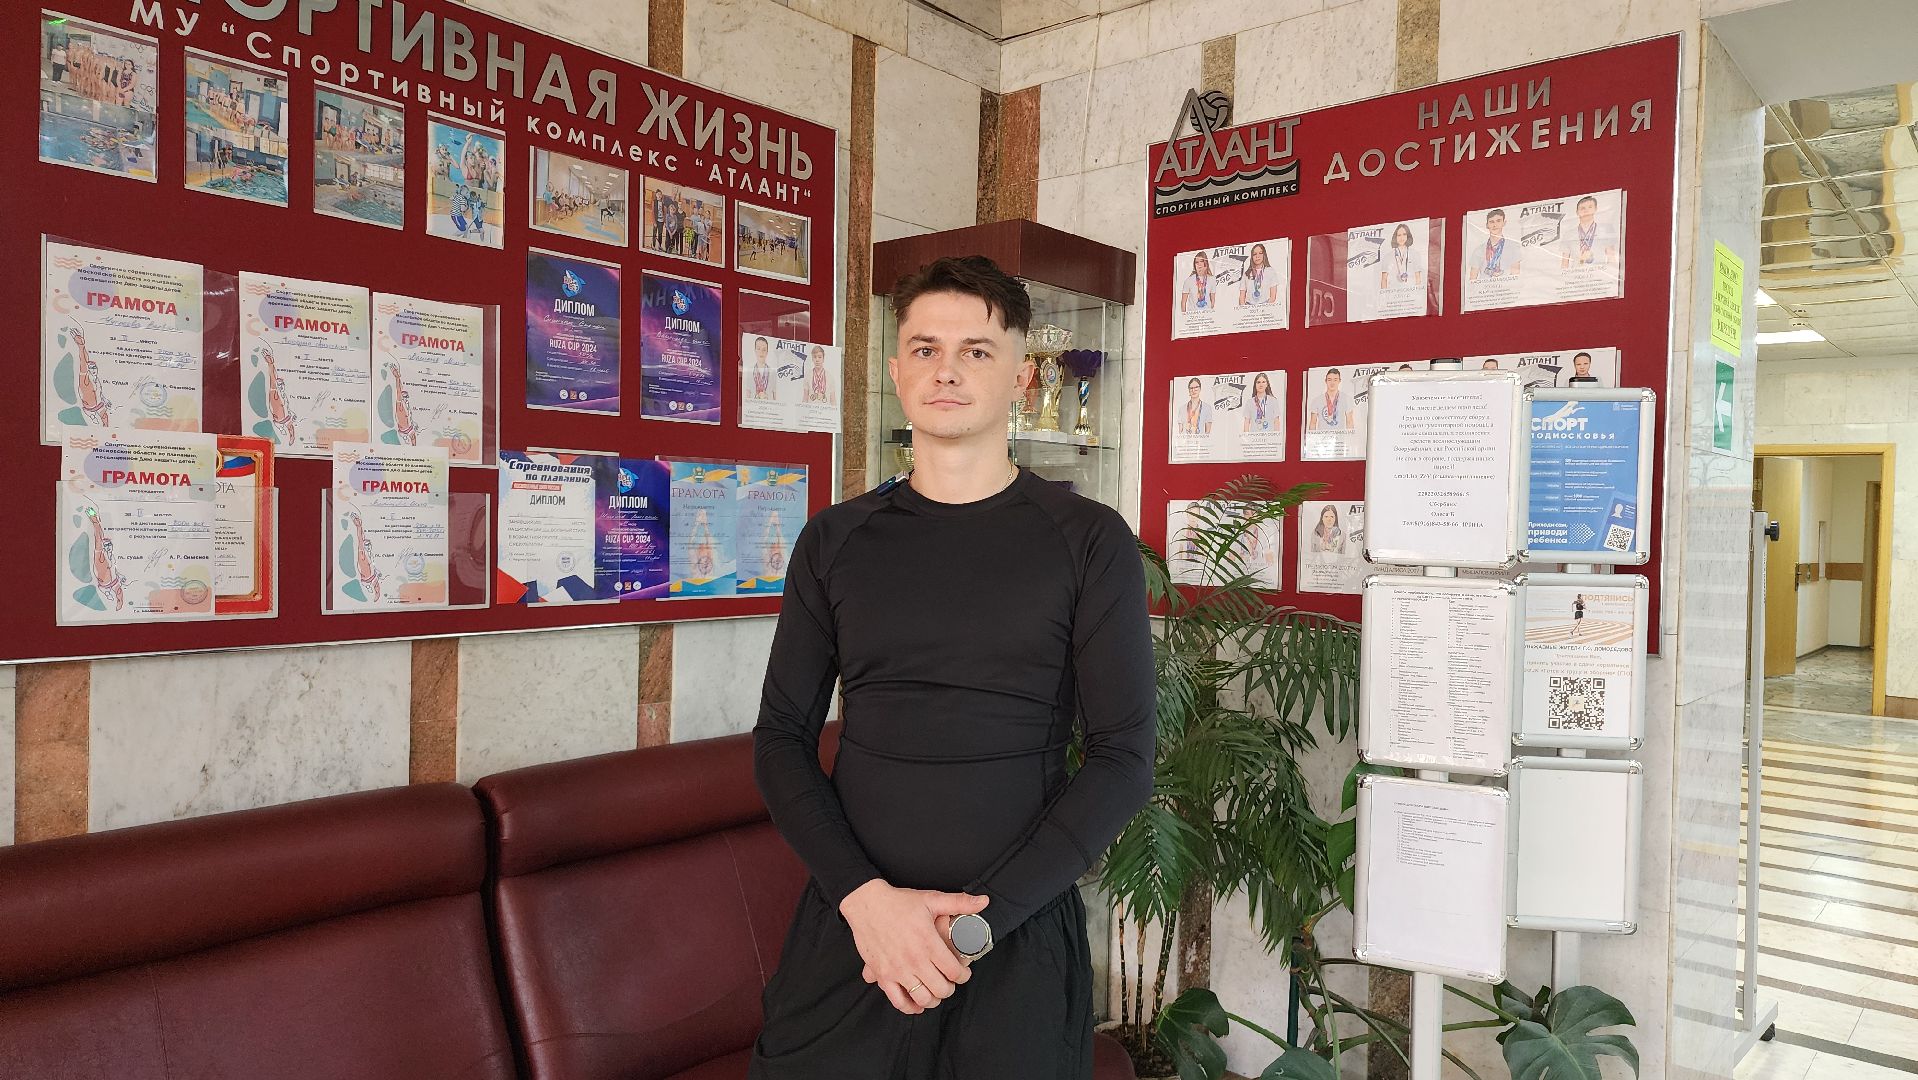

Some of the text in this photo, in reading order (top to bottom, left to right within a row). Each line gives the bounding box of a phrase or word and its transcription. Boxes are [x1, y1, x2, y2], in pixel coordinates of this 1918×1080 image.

[129, 0, 199, 37] МУ
[1418, 76, 1552, 130] НАШИ
[637, 81, 814, 181] ЖИЗНЬ
[1154, 88, 1300, 183] АТЛАНТ
[1322, 99, 1653, 185] ДОСТИЖЕНИЯ
[1156, 184, 1298, 215] СПОРТИВНЫЙ КОМПЛЕКС
[87, 291, 177, 316] ГРАМОТА
[554, 298, 595, 317] ДИПЛОМ
[274, 315, 350, 335] ГРАМОТА
[665, 316, 700, 333] ДИПЛОМ
[401, 332, 466, 352] ГРАМОТА
[568, 340, 580, 351] CUP
[581, 341, 597, 353] 2024
[1531, 417, 1588, 431] СПОРТ
[509, 460, 591, 475] Соревнования
[102, 470, 192, 487] ГРАМОТА
[362, 480, 430, 494] ГРАМОТА
[525, 473, 591, 484] по плаванию
[530, 494, 566, 506] ДИПЛОМ
[671, 487, 726, 499] ГРАМОТА
[748, 490, 797, 501] ГРАМОТА
[609, 495, 648, 510] ДИПЛОМ
[635, 534, 651, 544] 2024
